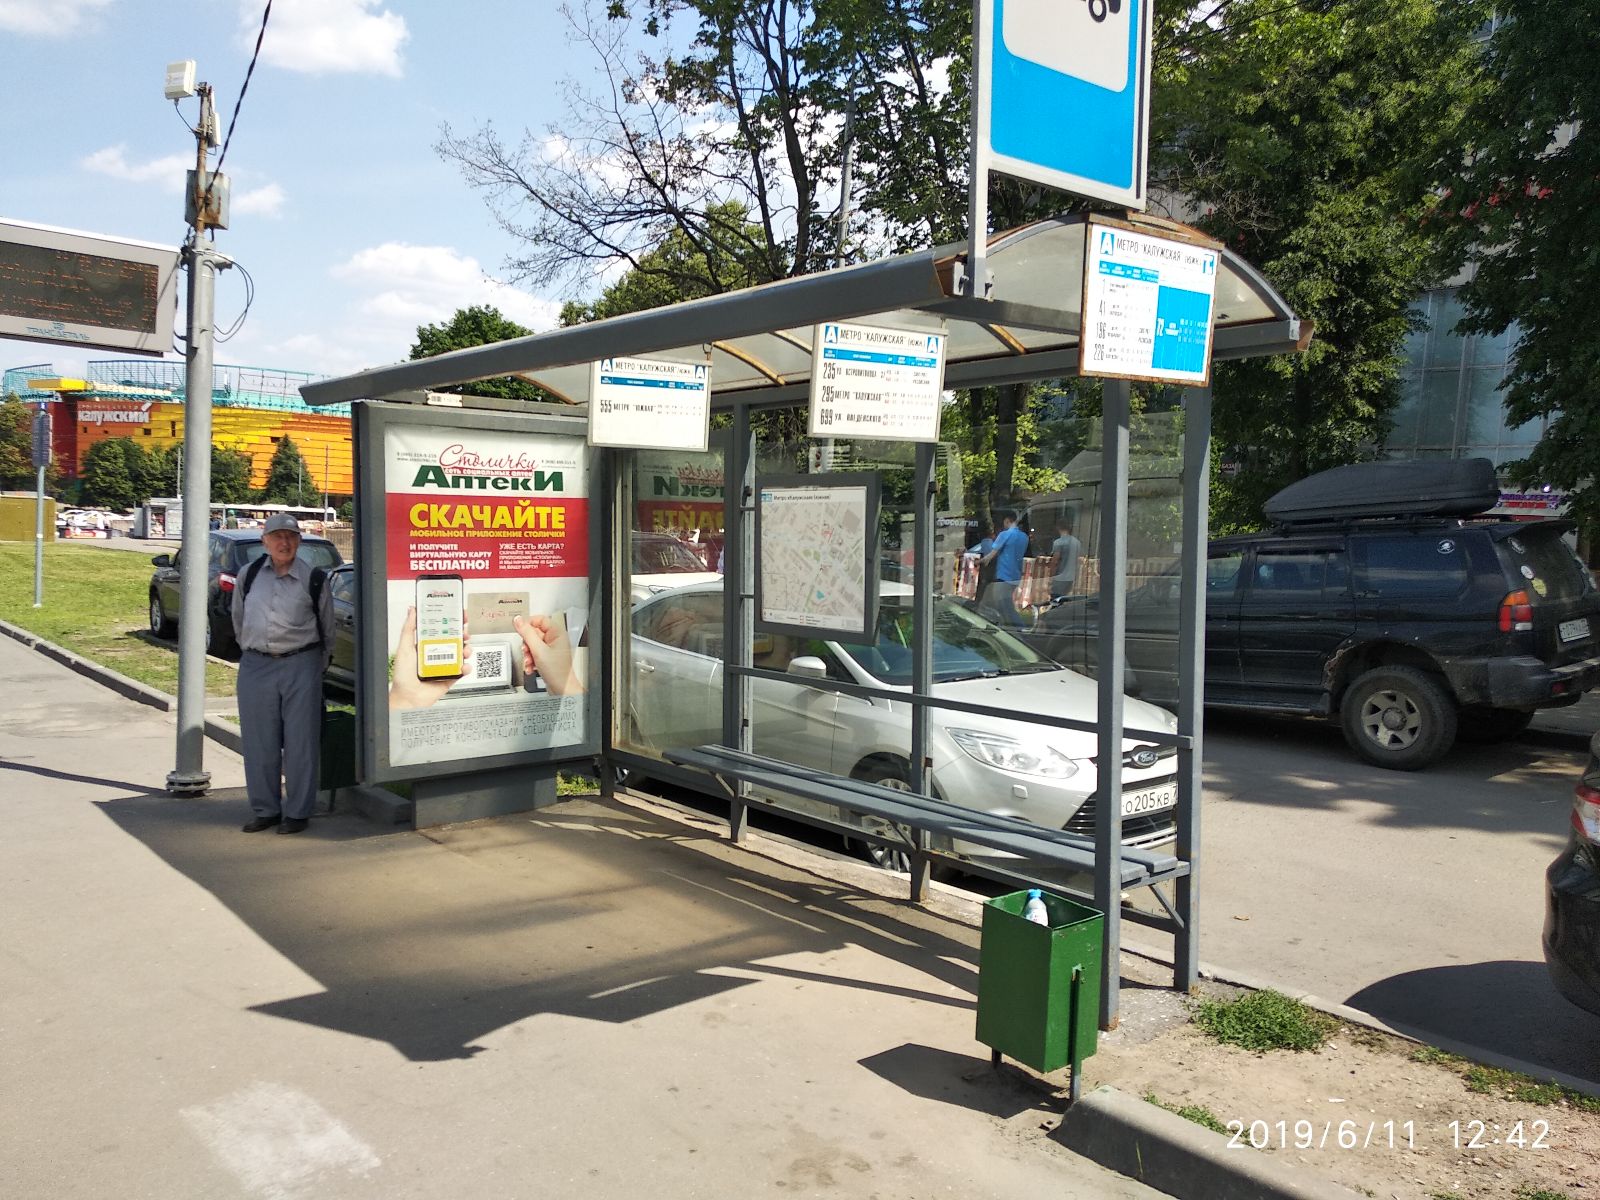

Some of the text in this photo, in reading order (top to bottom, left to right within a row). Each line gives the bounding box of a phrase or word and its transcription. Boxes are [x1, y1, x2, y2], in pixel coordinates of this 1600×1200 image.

[1116, 238, 1139, 253] МЕТРО
[840, 329, 862, 340] МЕТРО
[615, 362, 636, 370] МЕТРО
[823, 362, 836, 380] 235
[440, 444, 538, 470] Столички
[410, 500, 566, 528] СКАЧАЙТЕ
[410, 560, 490, 570] БЕСПЛАТНО!
